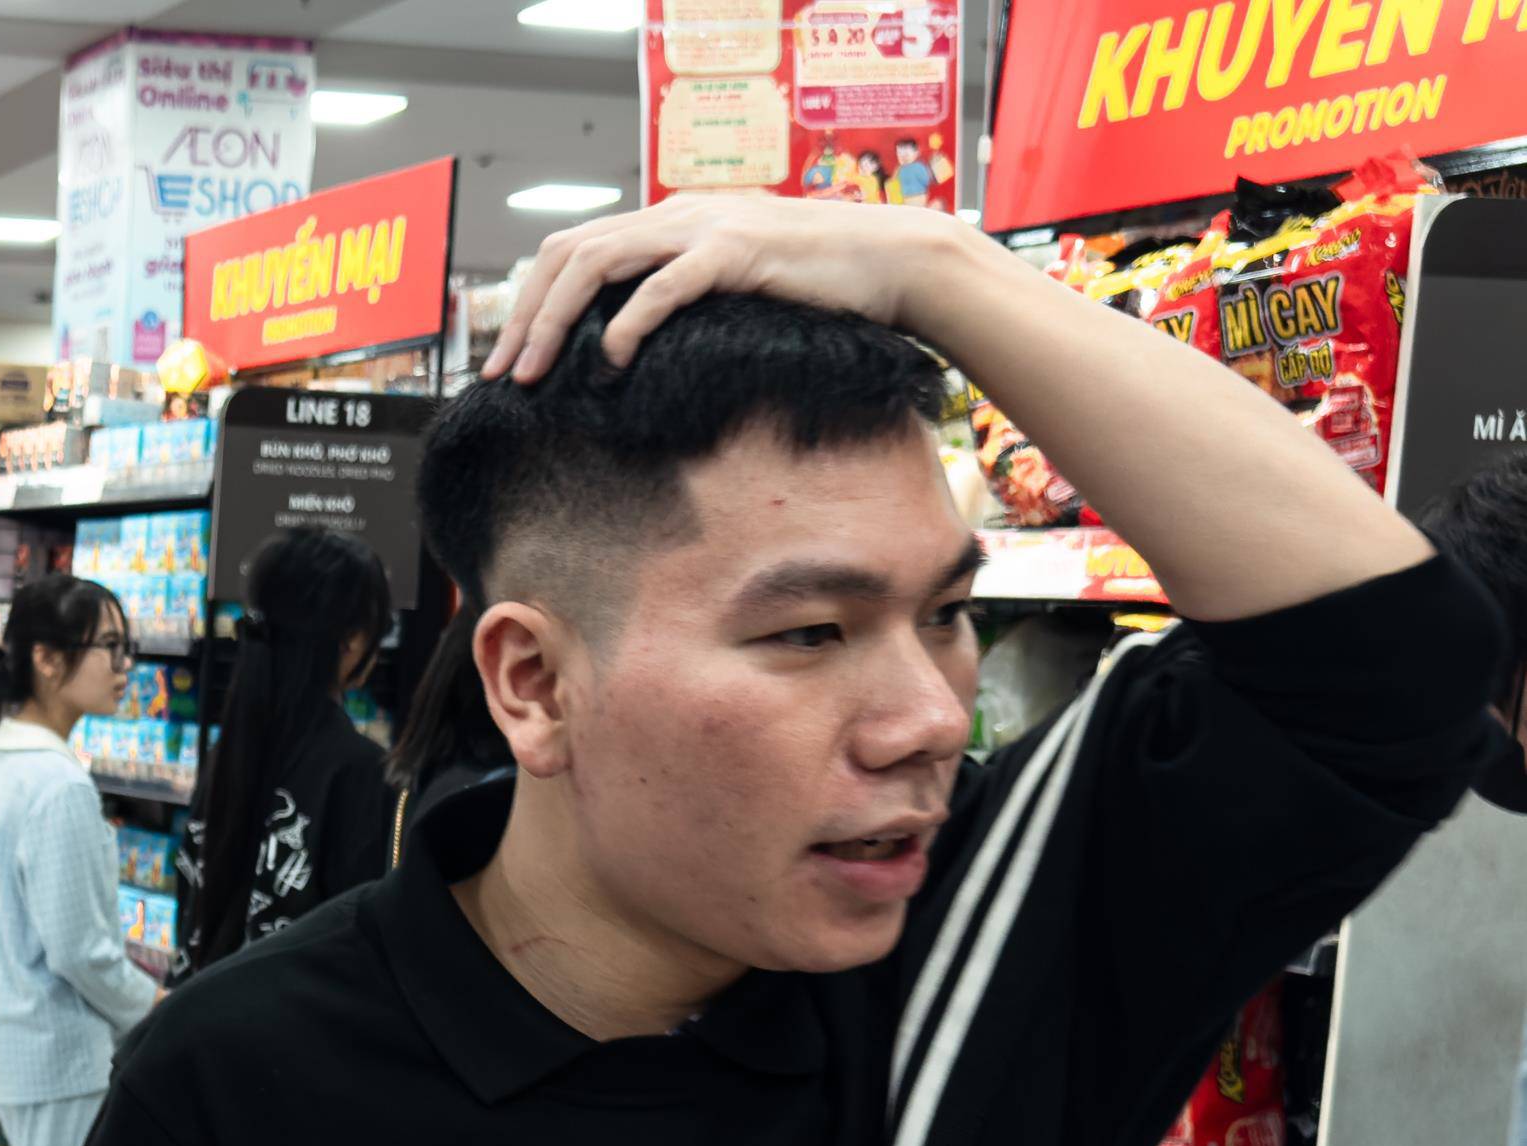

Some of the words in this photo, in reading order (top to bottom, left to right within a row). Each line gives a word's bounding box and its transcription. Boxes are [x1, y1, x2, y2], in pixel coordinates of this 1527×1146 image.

[139, 83, 231, 113] Online
[1224, 75, 1448, 158] PROMOTION
[210, 214, 337, 321] KHUYẾN
[336, 214, 407, 304] MẠI
[1224, 286, 1266, 350] MÌ
[1270, 277, 1341, 340] CAY
[287, 397, 339, 426] LINE
[345, 400, 372, 427] 18
[1473, 408, 1504, 441] MÌ
